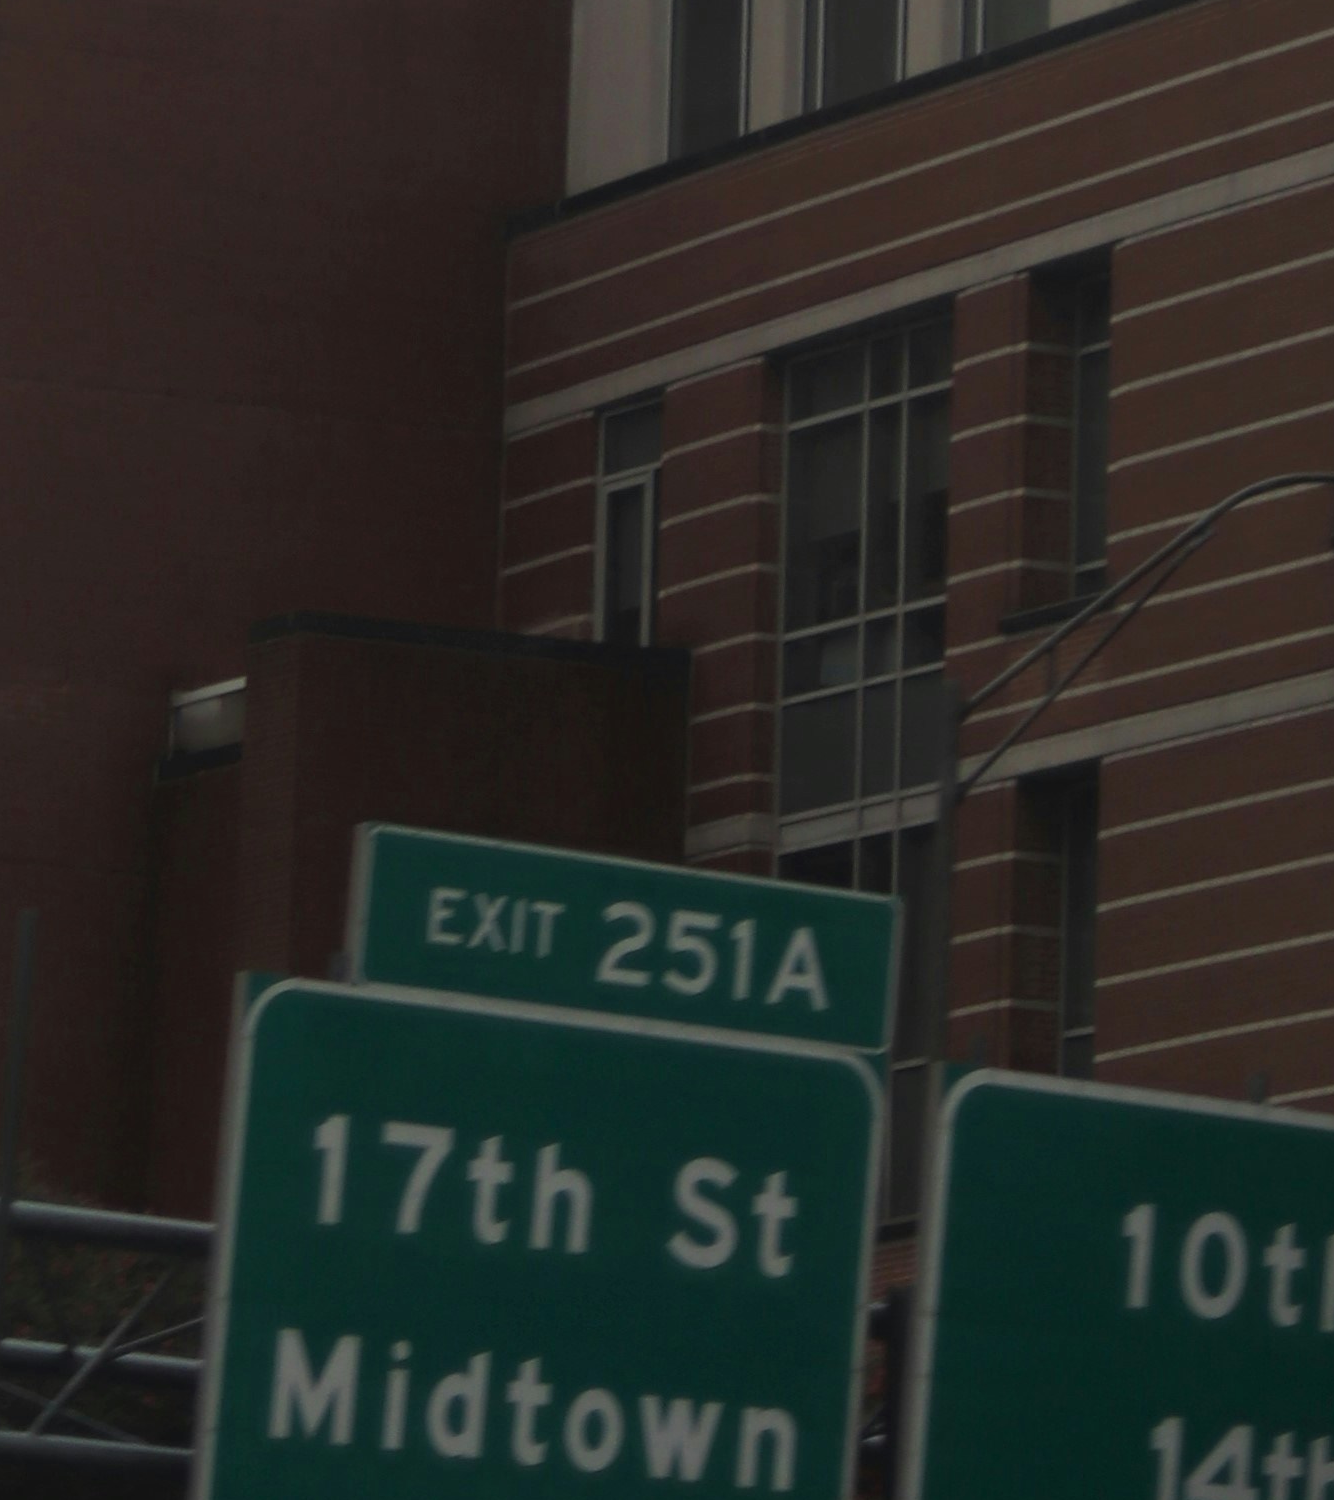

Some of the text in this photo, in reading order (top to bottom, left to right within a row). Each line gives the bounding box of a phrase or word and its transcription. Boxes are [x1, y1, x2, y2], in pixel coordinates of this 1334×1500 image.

[425, 888, 830, 1011] EXIT 251A
[312, 1113, 799, 1279] 17th St
[267, 1327, 798, 1494] Midtown
